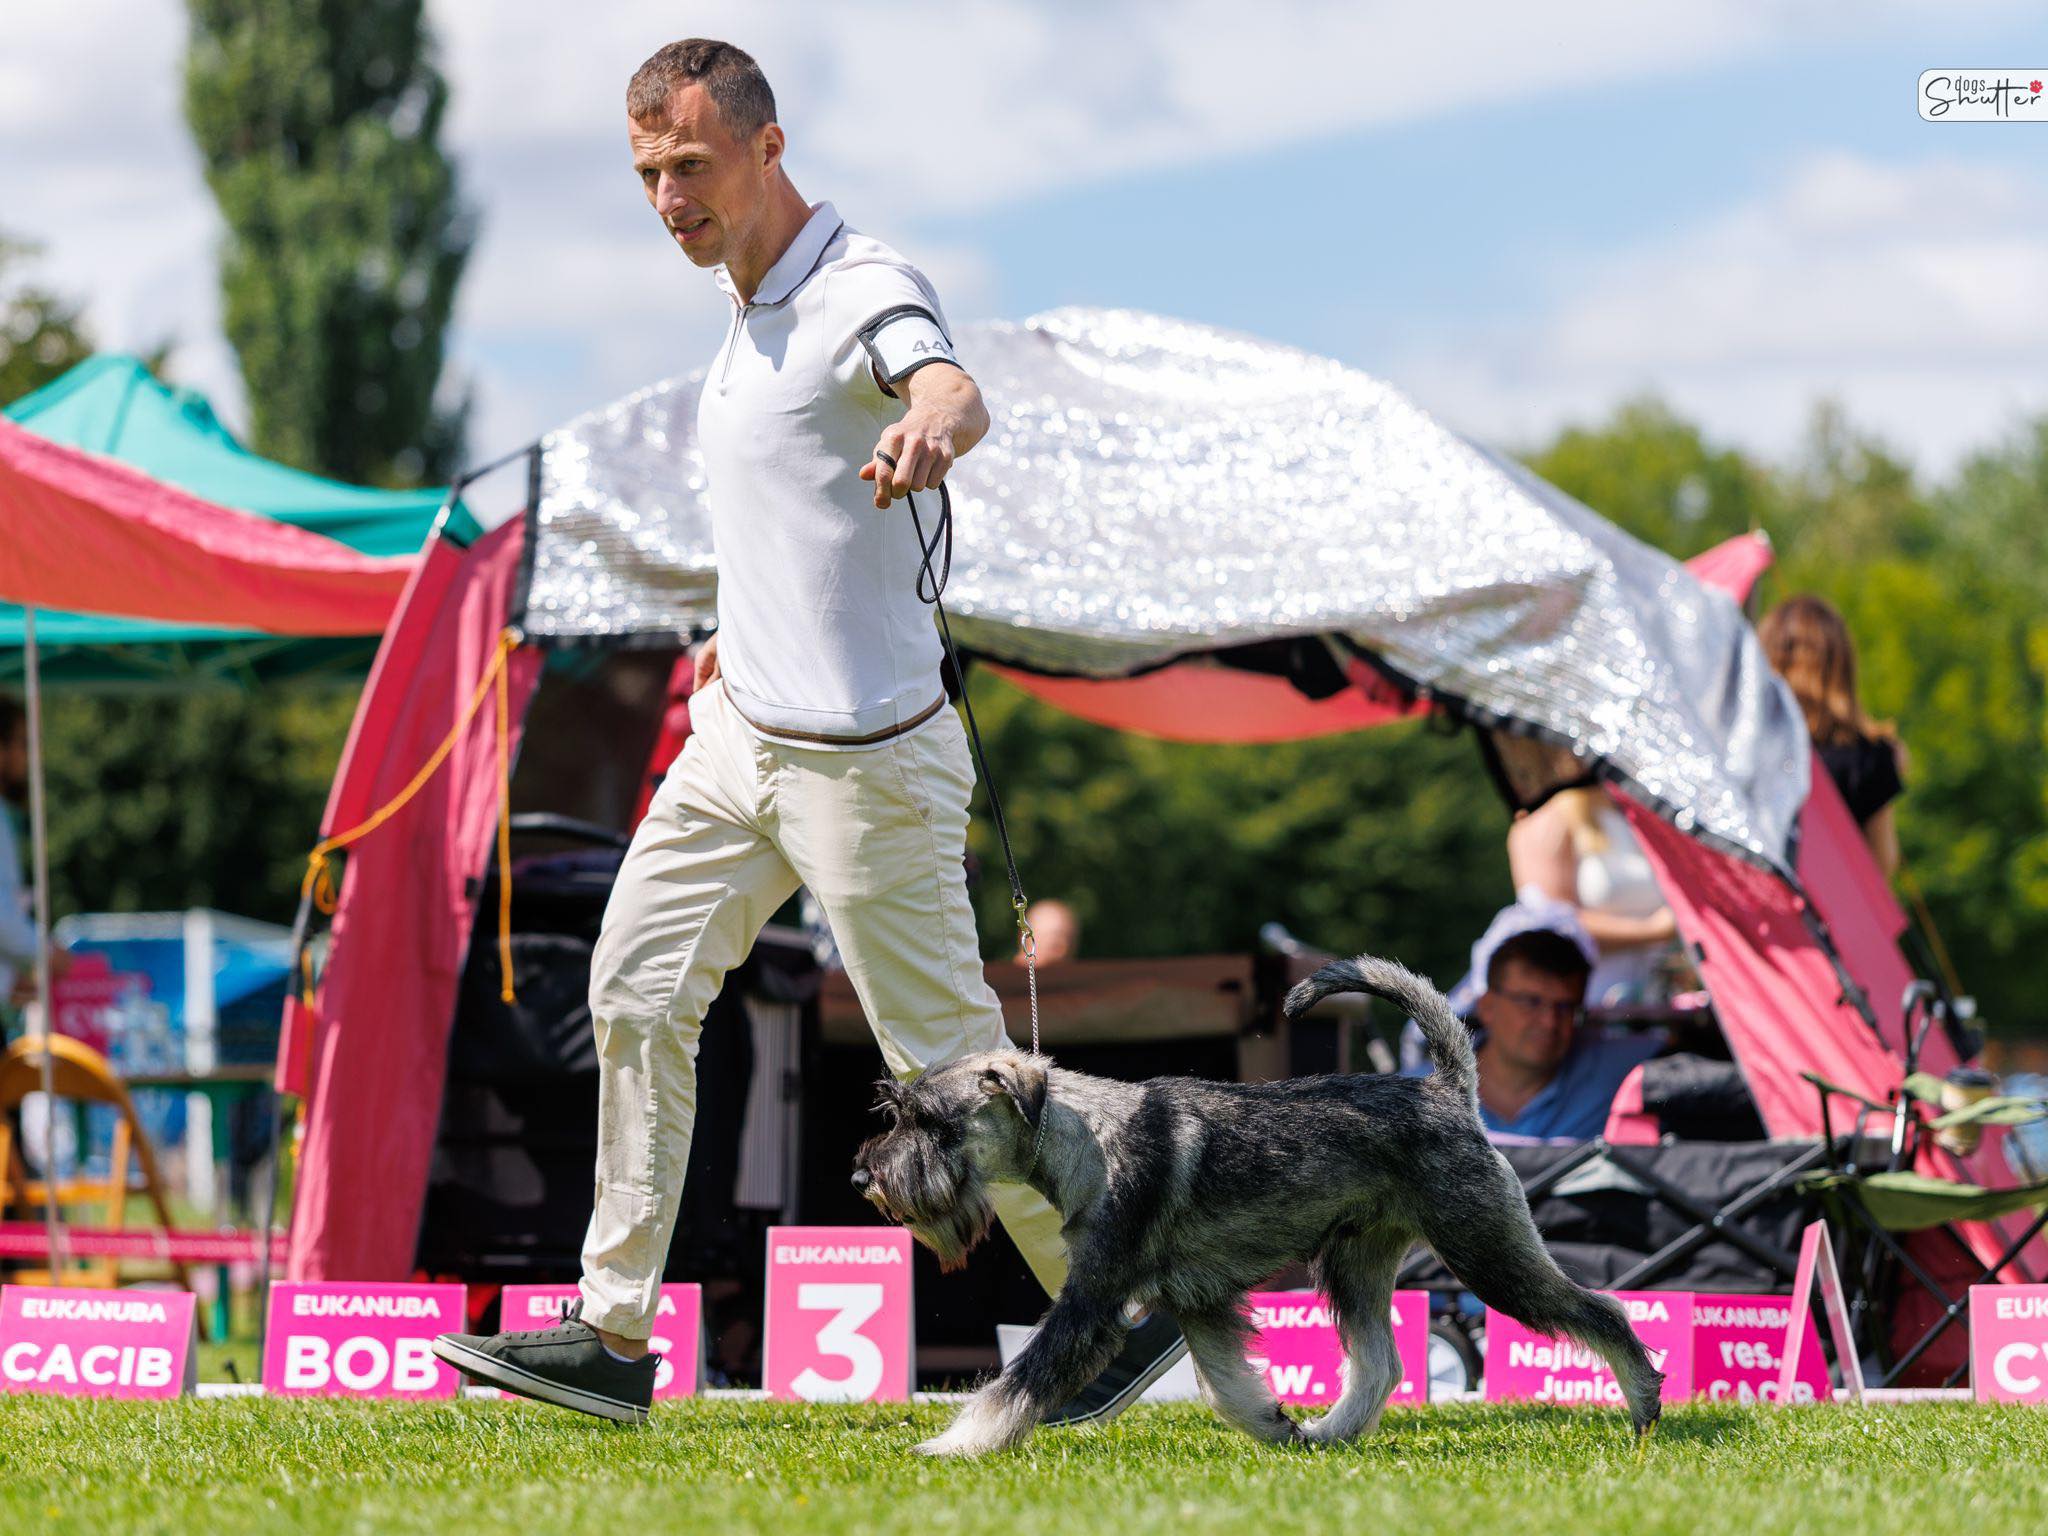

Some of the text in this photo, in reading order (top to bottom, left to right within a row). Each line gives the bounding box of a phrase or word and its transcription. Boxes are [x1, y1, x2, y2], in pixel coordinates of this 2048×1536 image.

[775, 1245, 902, 1265] EUKANUBA
[20, 1298, 167, 1323] EUKANUBA
[293, 1294, 441, 1318] EUKANUBA
[1692, 1305, 1790, 1328] UKANUBA
[790, 1283, 884, 1402] 3
[2, 1342, 173, 1387] CACIB
[285, 1335, 439, 1390] BOB
[1993, 1342, 2048, 1394] C
[1534, 1375, 1627, 1401] Junio
[1709, 1379, 1817, 1406] CACB
